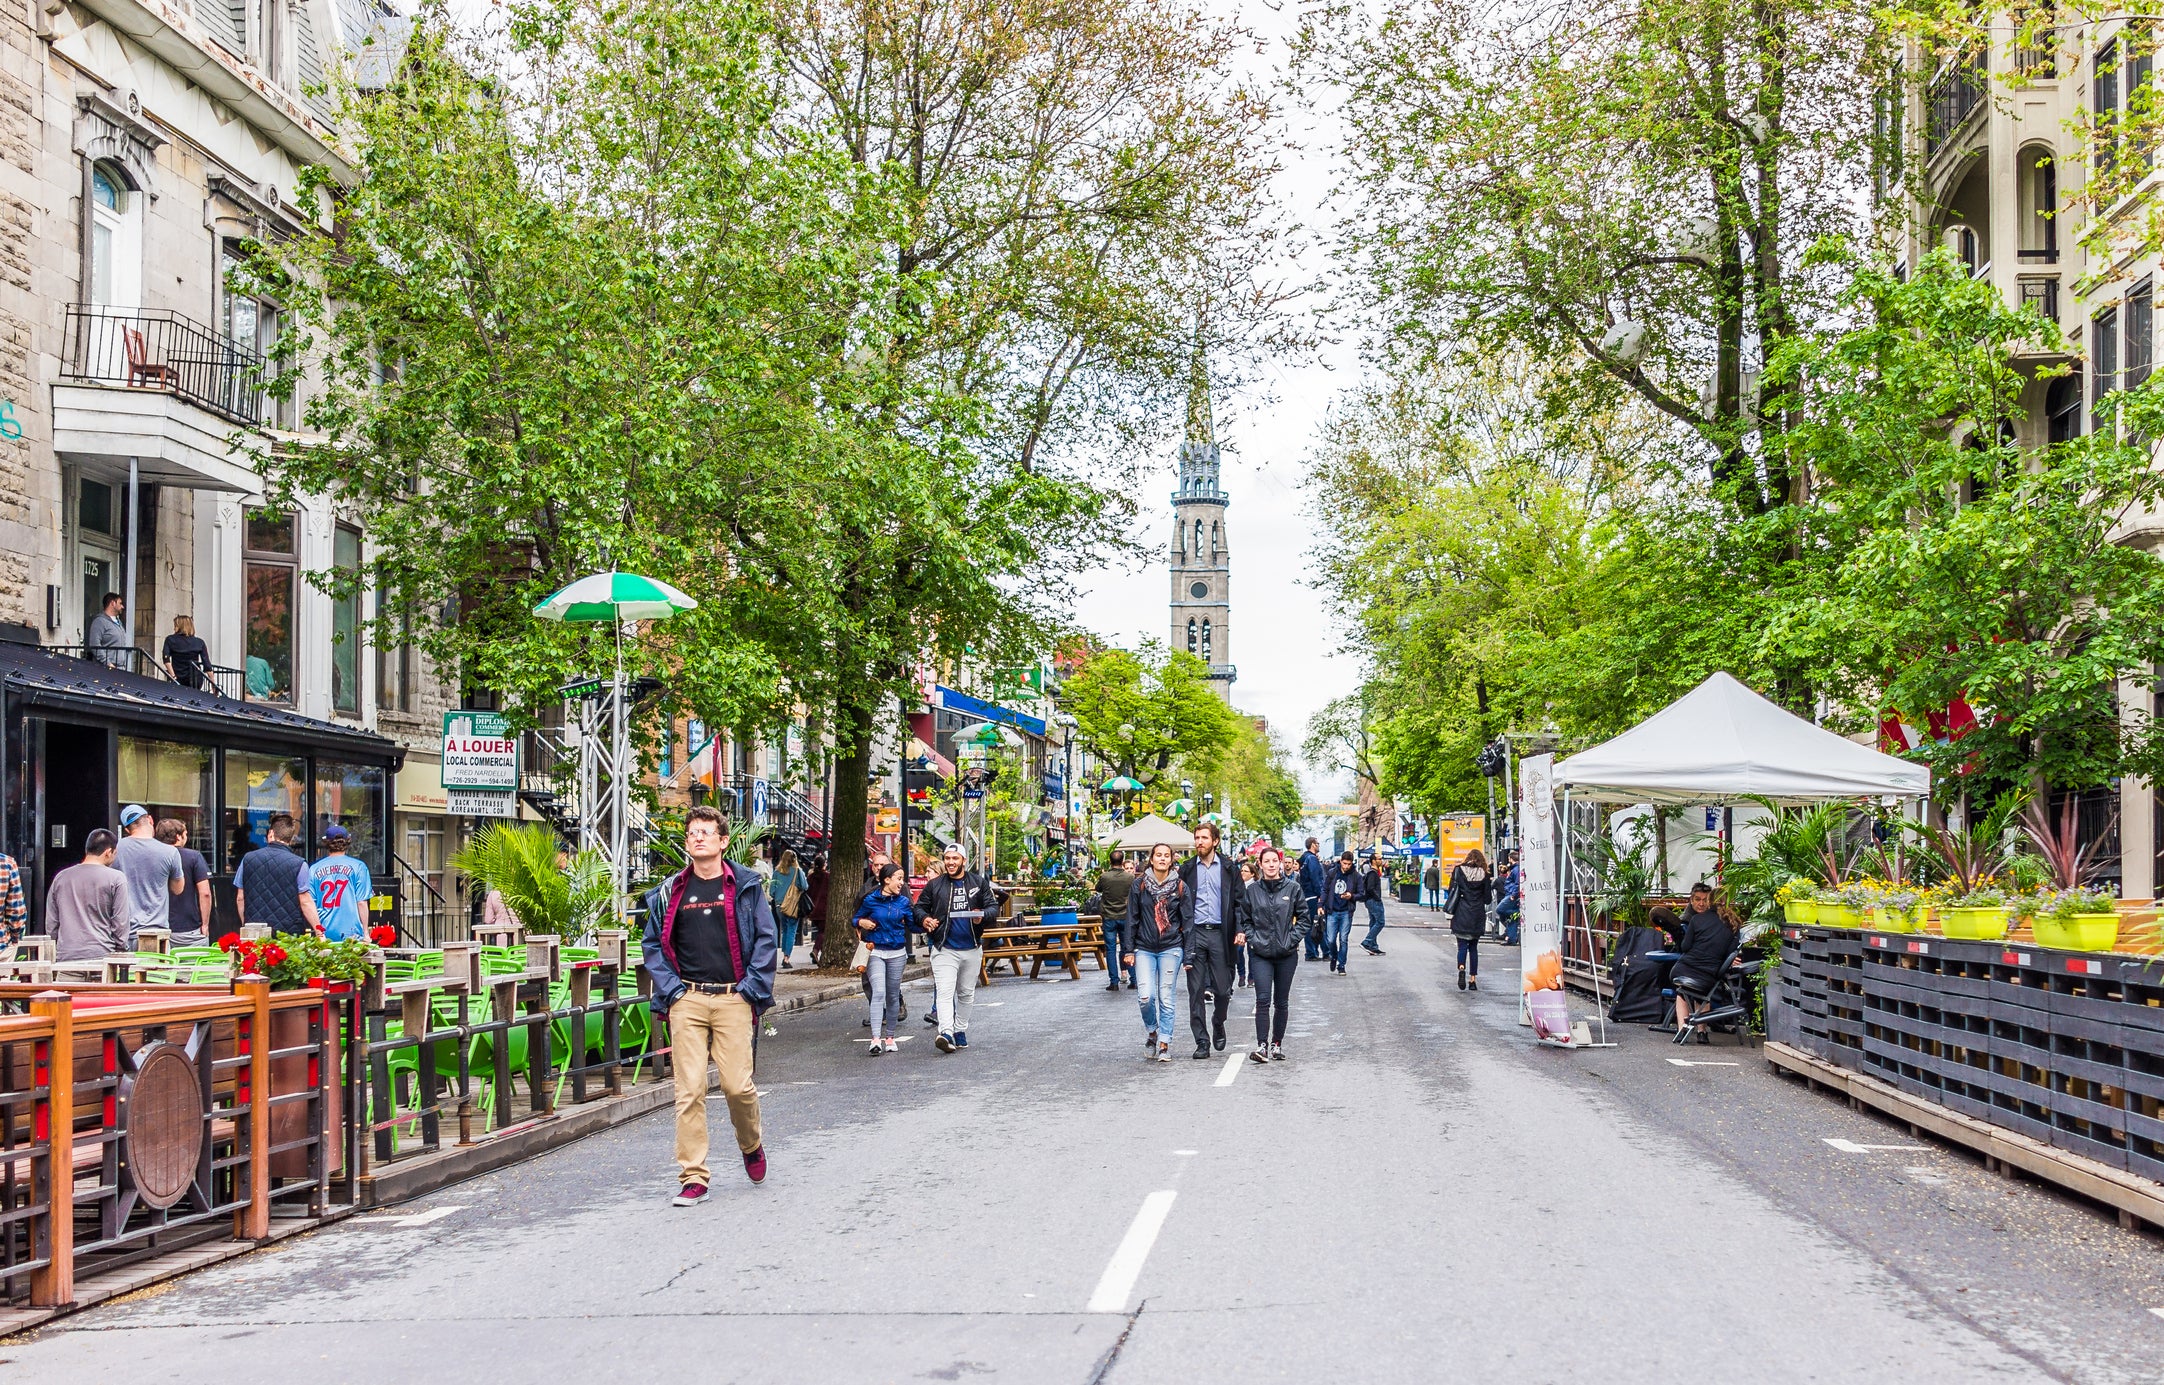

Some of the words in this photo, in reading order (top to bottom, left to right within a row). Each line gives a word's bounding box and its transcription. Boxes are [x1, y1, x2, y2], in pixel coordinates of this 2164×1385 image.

[84, 560, 98, 577] 1725
[462, 739, 515, 754] LOUER
[446, 756, 468, 766] LOCAL
[469, 756, 514, 767] COMMERCIAL
[475, 770, 507, 778] NARDELLI
[450, 790, 480, 798] TERRASSE
[474, 800, 504, 808] TERRASSE
[320, 879, 350, 909] 27
